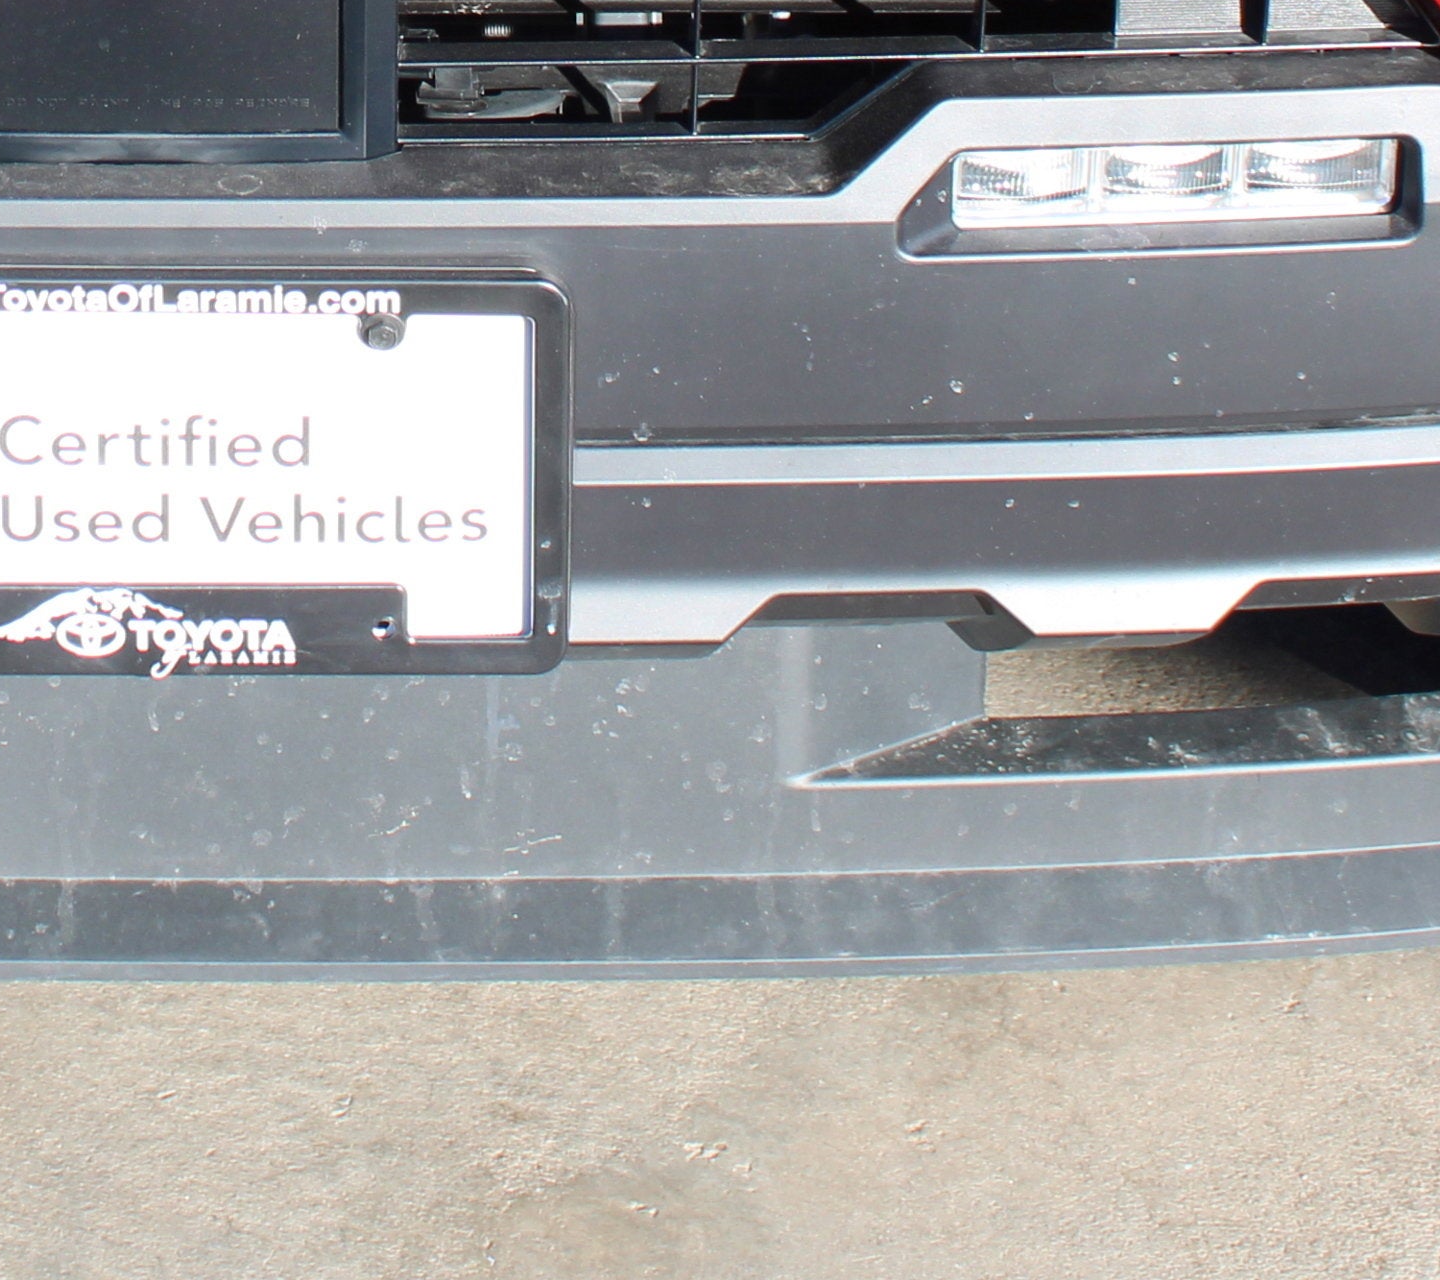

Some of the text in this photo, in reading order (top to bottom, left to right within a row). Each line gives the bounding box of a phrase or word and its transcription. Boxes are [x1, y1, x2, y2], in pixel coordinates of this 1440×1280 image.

[0, 493, 489, 543] Used Vehicles
[127, 618, 297, 652] TOYOTA
